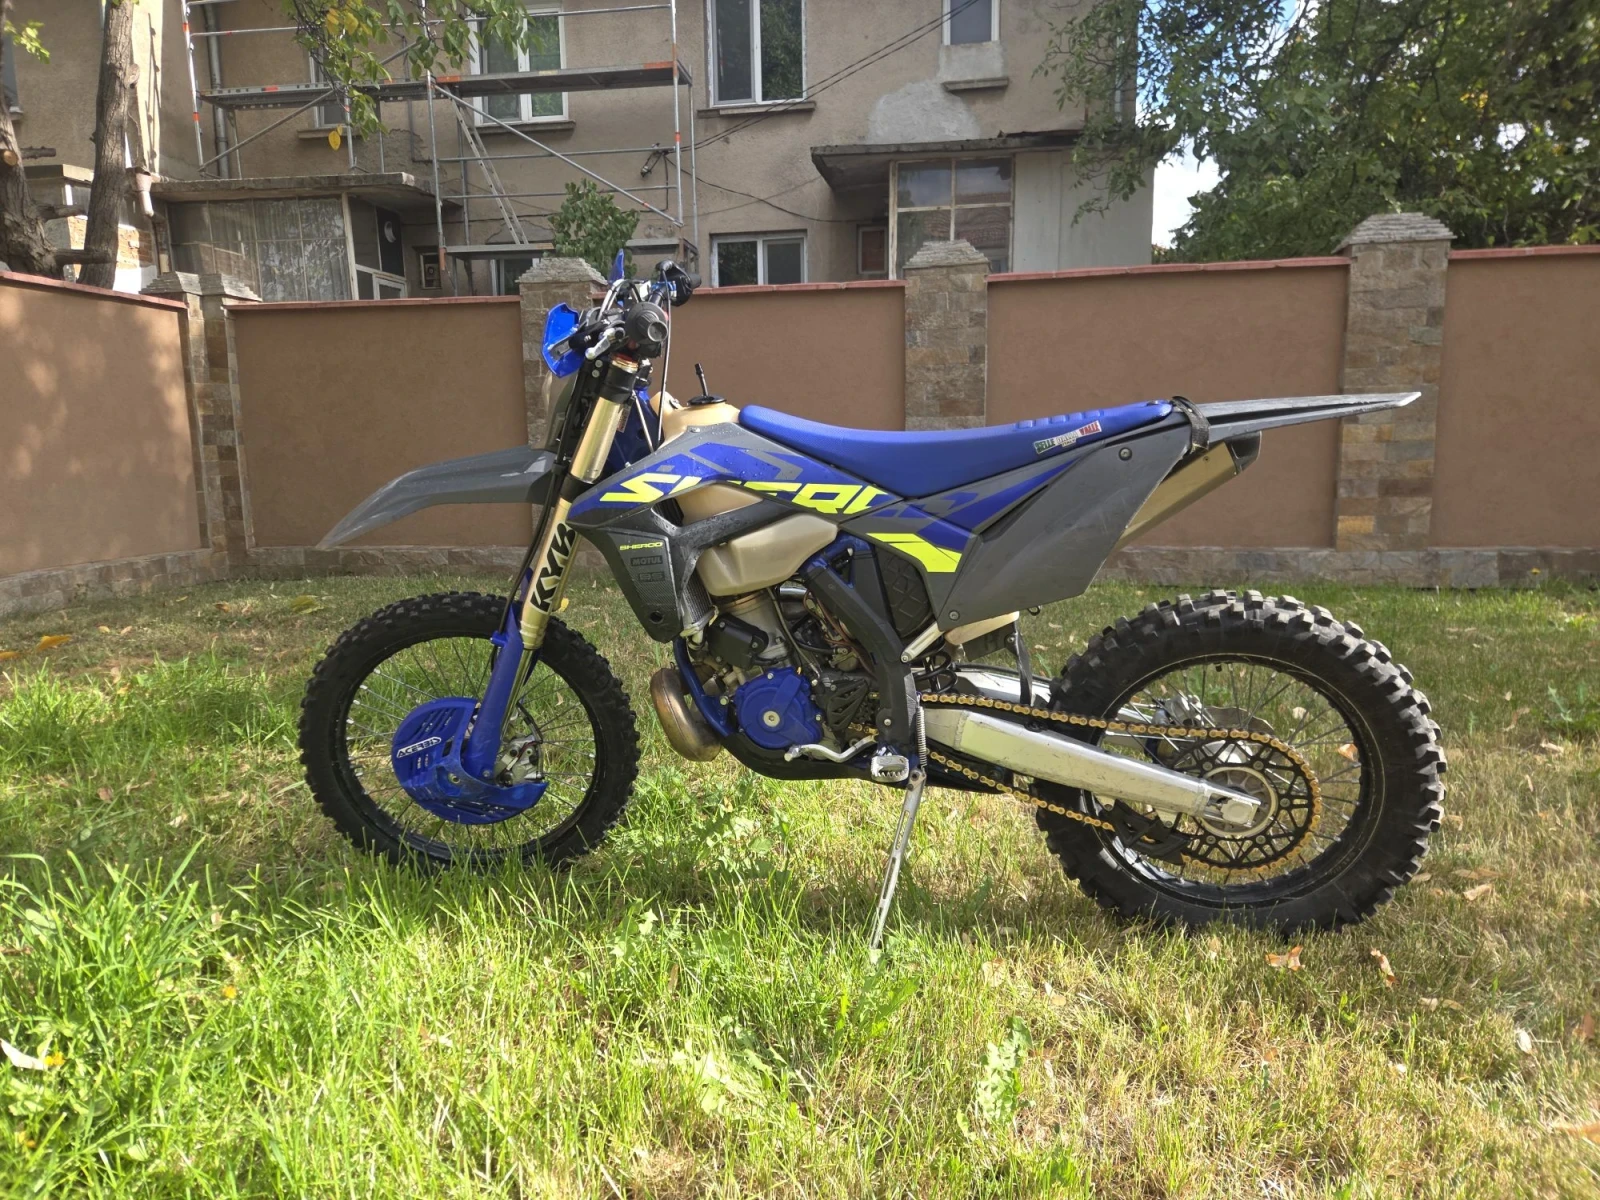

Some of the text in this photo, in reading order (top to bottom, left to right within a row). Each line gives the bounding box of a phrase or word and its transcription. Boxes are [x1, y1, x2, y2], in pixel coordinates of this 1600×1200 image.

[619, 542, 663, 551] SHERCO
[530, 523, 576, 612] KYB
[632, 556, 662, 566] MOTUL
[398, 737, 441, 757] ACERBIS
